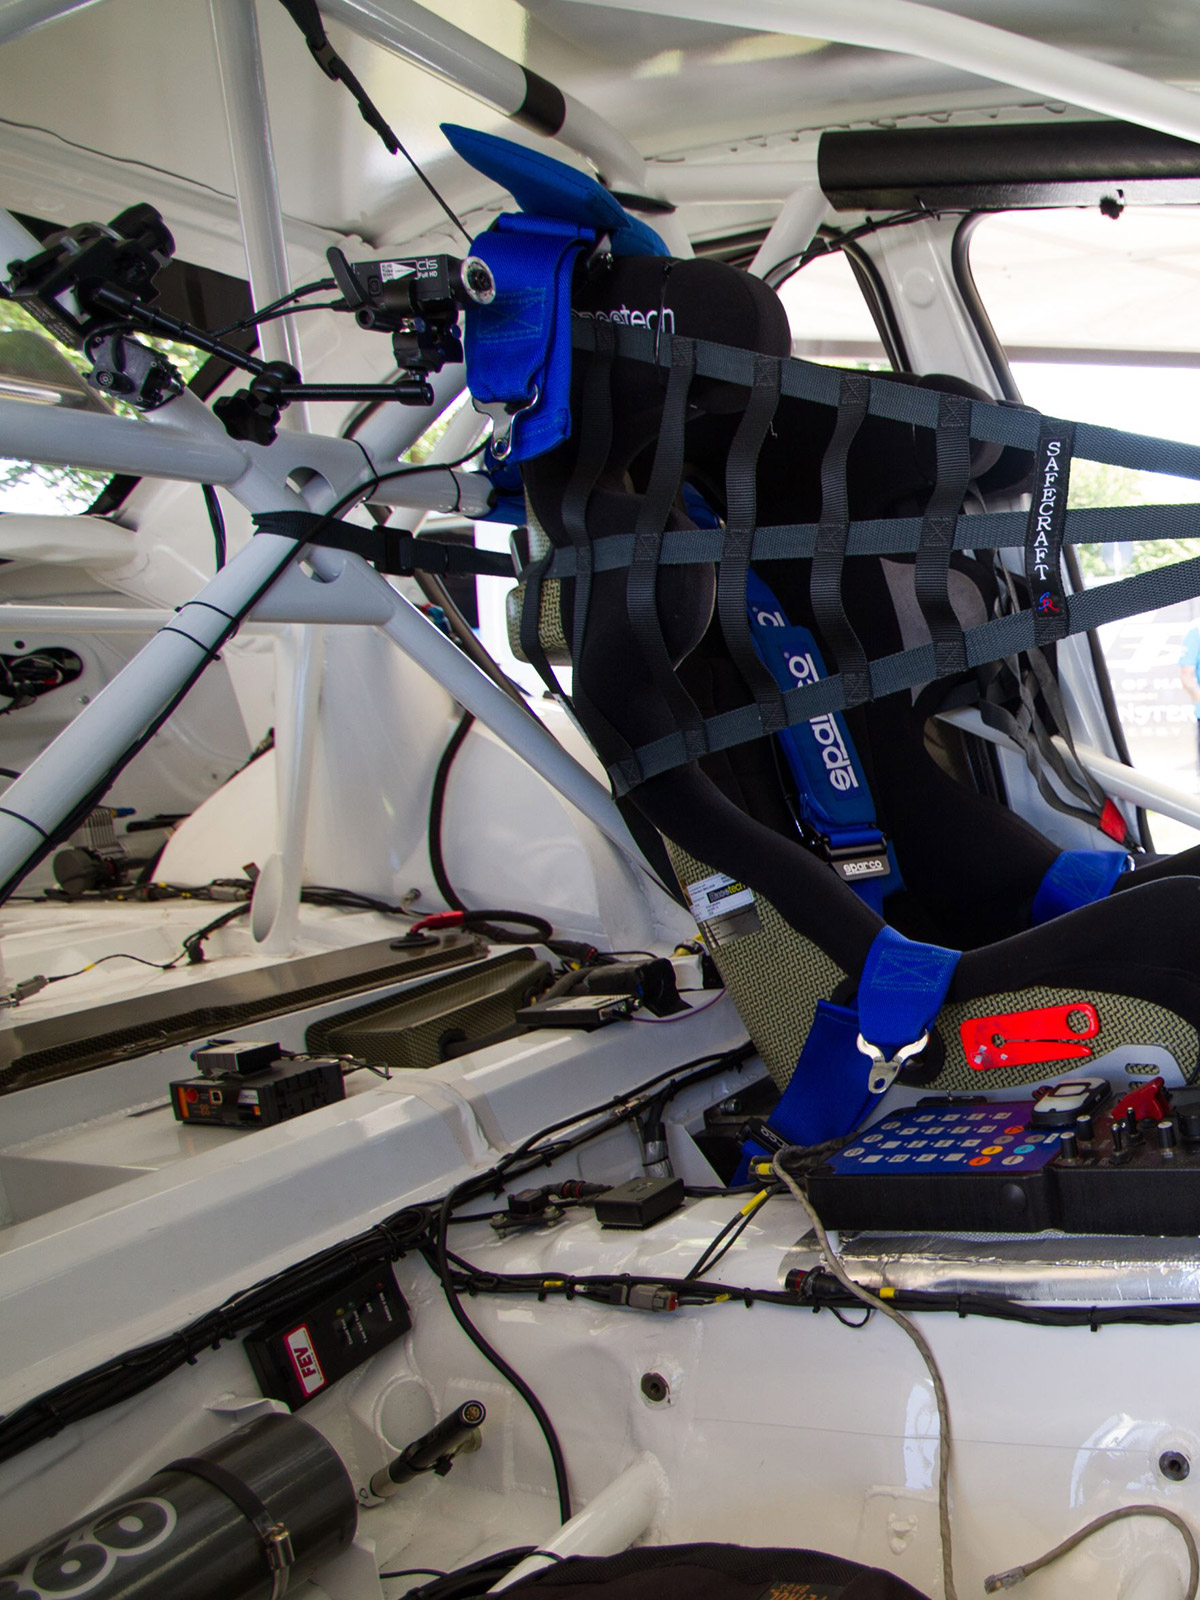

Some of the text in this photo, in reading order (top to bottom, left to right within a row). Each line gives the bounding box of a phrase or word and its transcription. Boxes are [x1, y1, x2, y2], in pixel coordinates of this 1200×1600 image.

[1034, 441, 1061, 581] SAFECRAFT
[785, 652, 859, 792] spao
[843, 860, 884, 876] sparco
[293, 1346, 317, 1379] FEV
